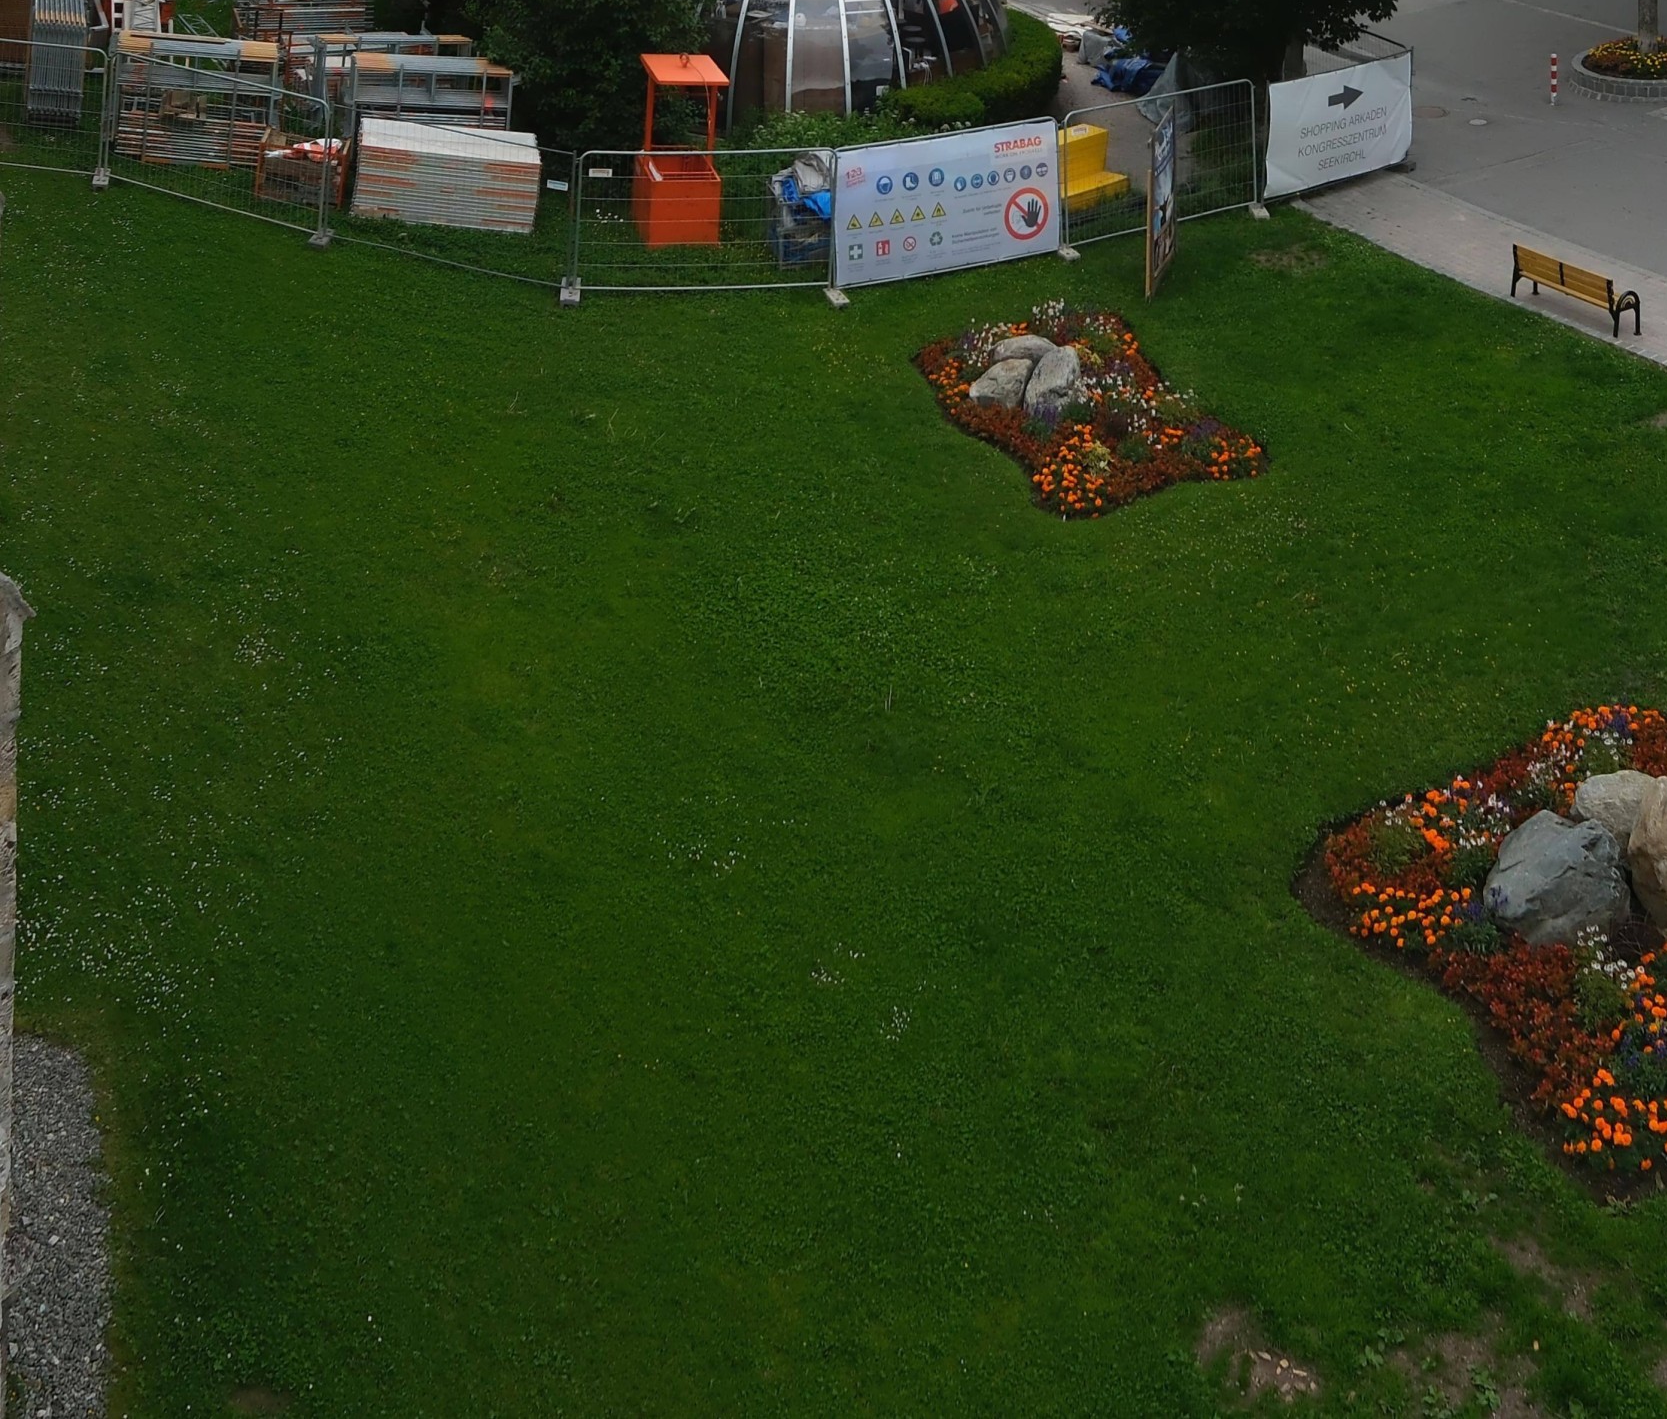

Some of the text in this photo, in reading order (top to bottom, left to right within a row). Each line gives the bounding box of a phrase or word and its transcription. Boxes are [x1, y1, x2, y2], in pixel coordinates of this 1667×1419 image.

[1300, 106, 1388, 139] SHOPPING ARKADEN
[994, 135, 1042, 154] STRABAG
[1297, 124, 1388, 158] KONGRESSZENTRUM
[1318, 150, 1367, 171] SEEKIRCHL
